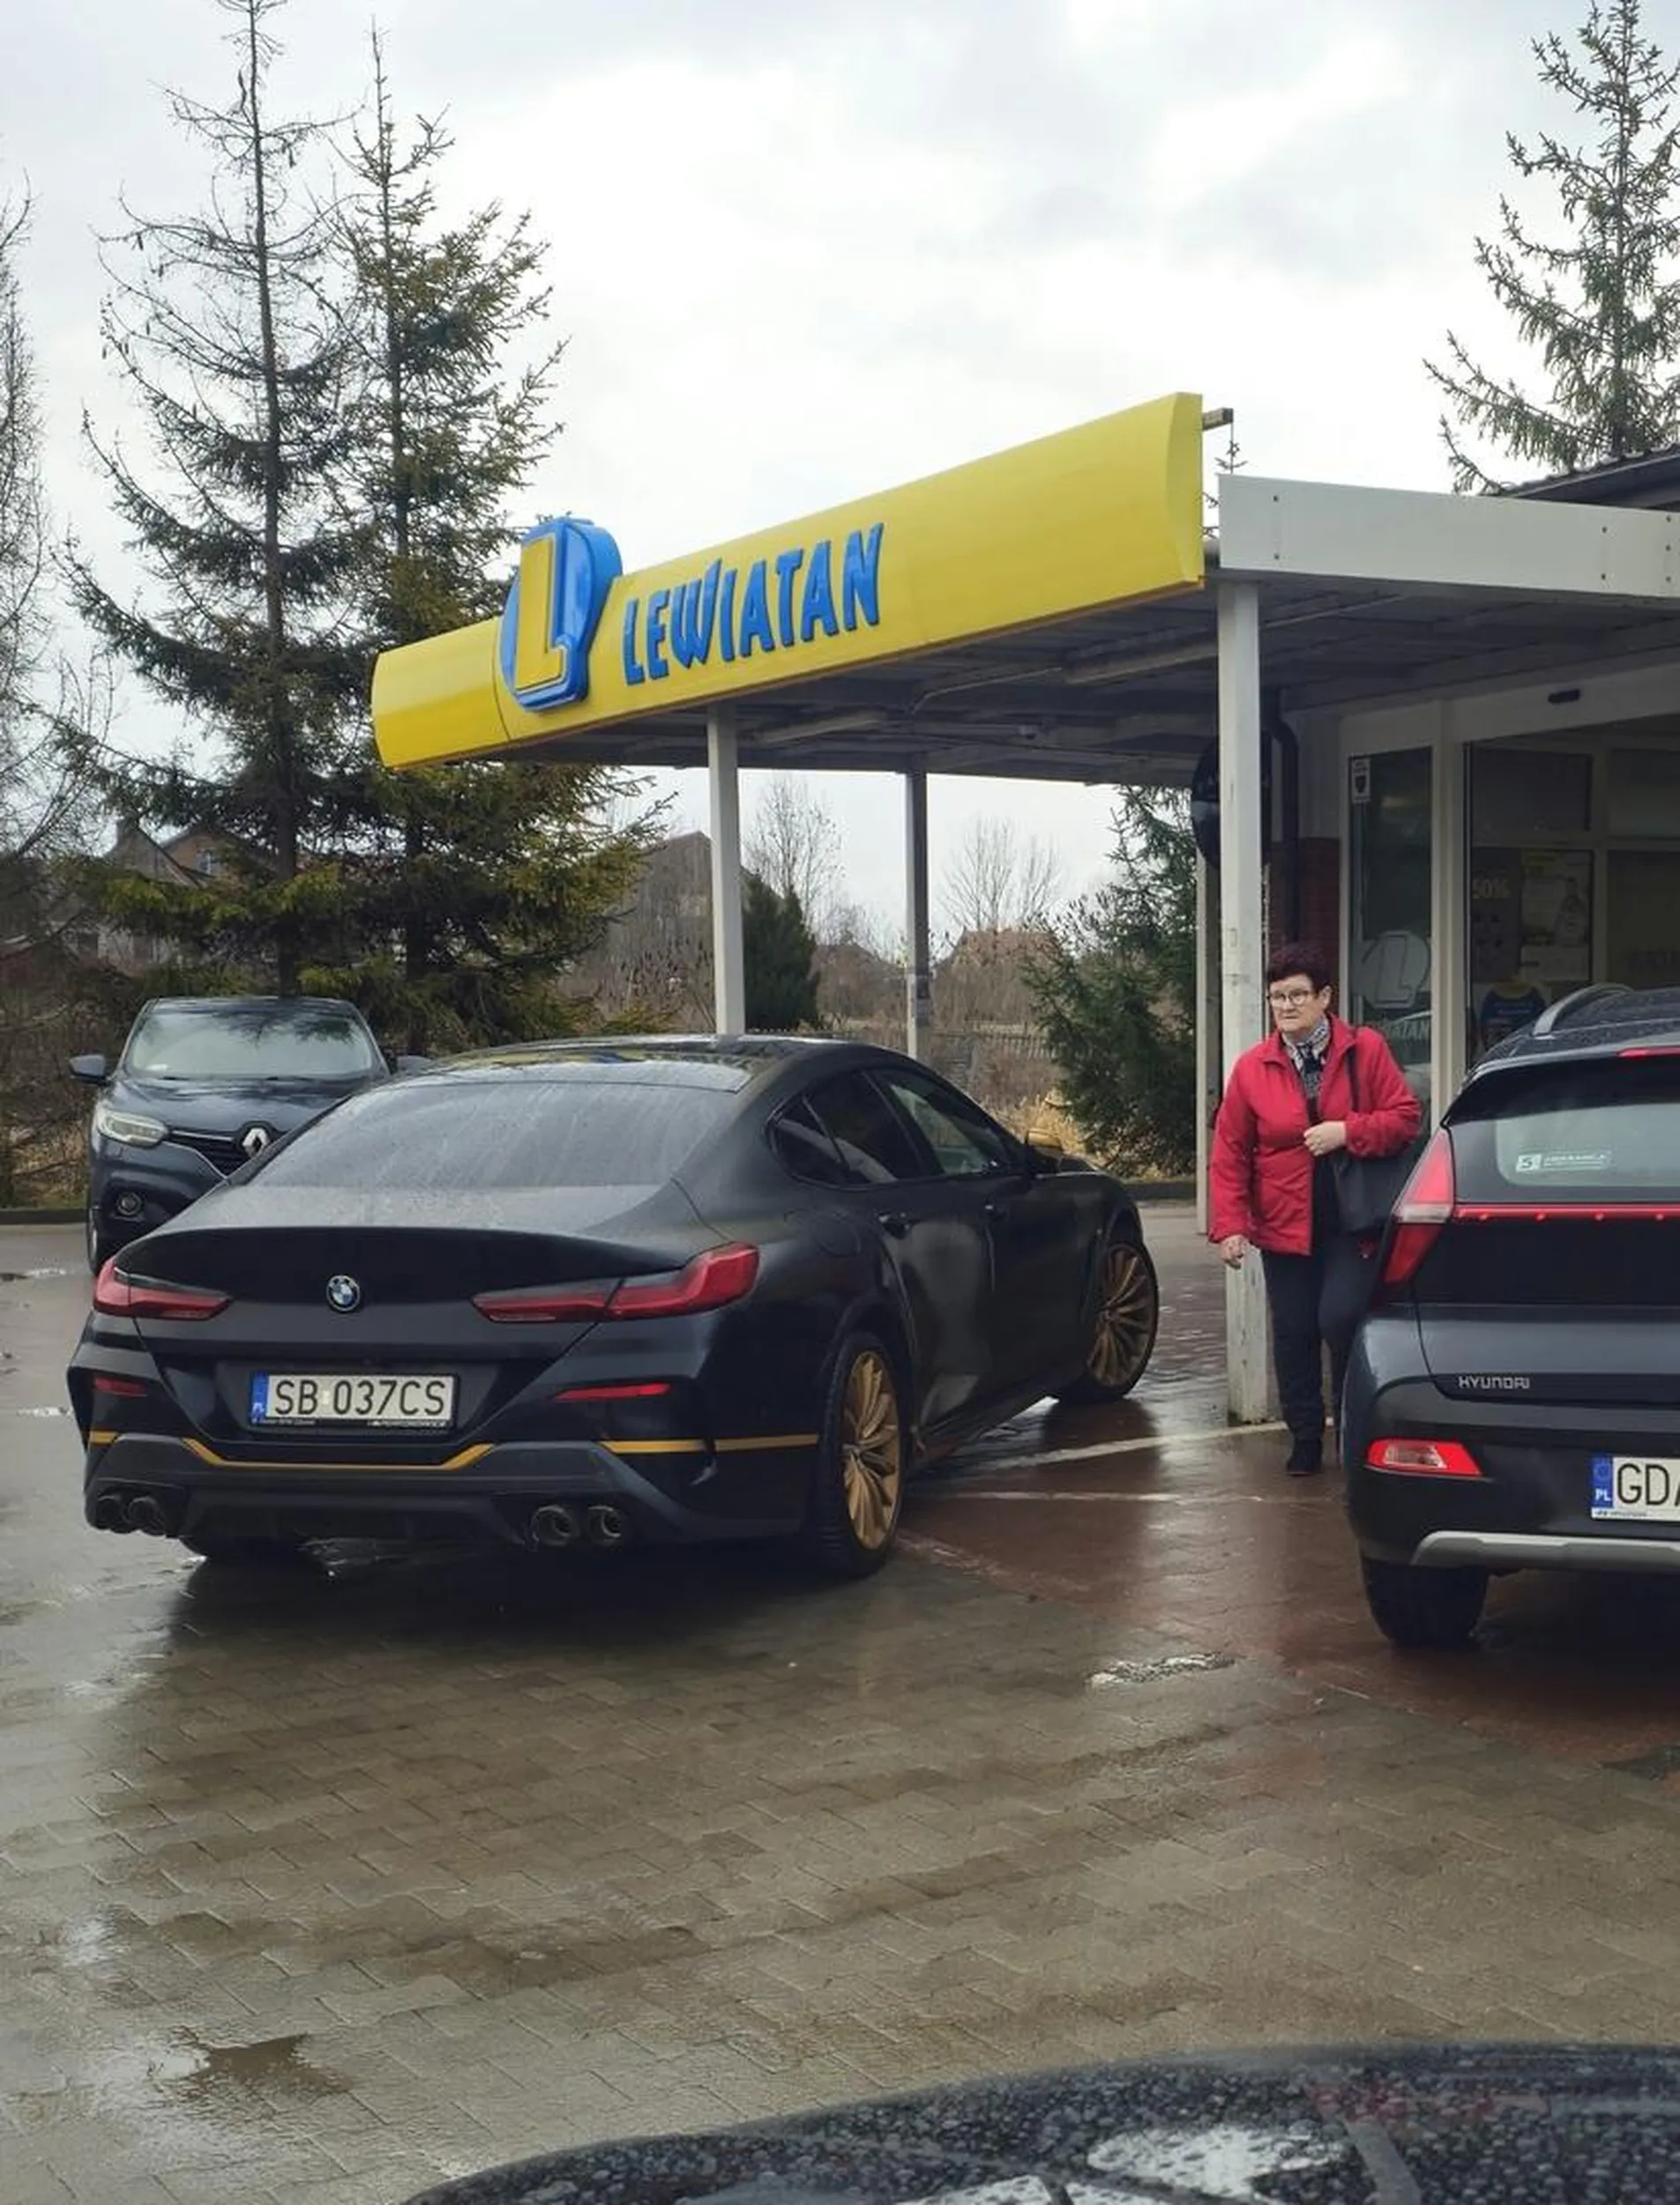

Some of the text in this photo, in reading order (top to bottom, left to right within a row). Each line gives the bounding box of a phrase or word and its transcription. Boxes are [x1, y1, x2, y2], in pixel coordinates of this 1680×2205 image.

[623, 522, 885, 686] LEWIATAN
[1458, 1375, 1530, 1389] HYUNDAI
[274, 1379, 447, 1416] SB 037CS
[1594, 1488, 1612, 1502] PL
